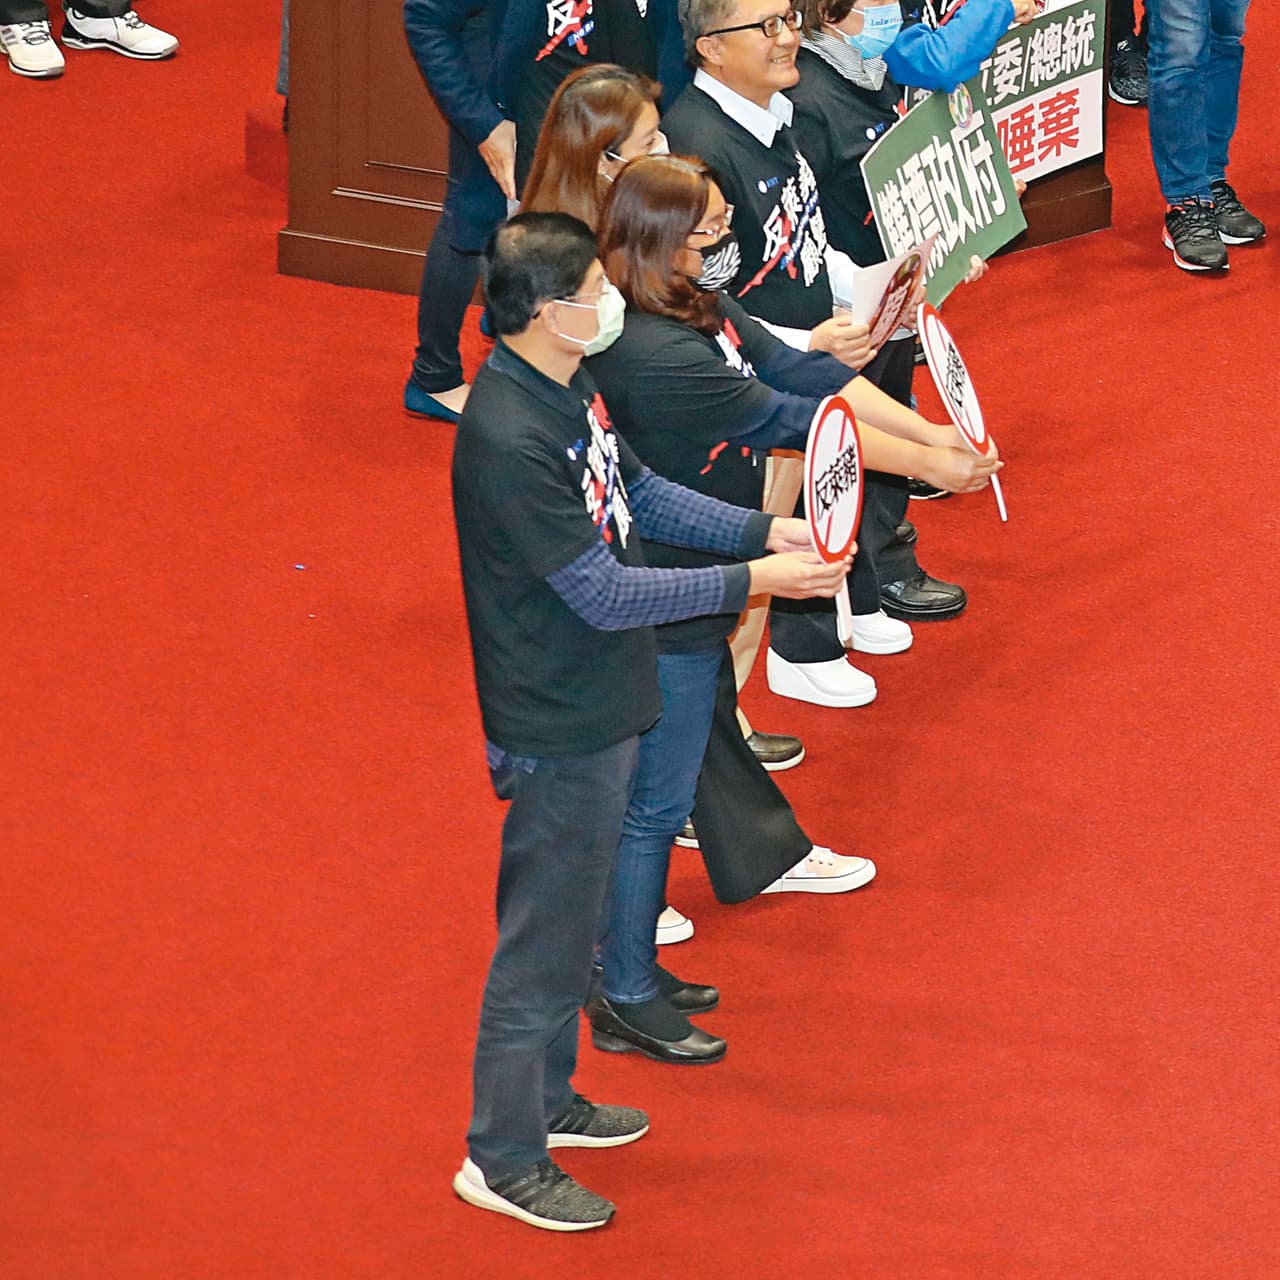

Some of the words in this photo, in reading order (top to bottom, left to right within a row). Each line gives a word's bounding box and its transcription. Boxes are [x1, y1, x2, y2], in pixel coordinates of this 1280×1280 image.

[996, 88, 1080, 174] 唾棄
[876, 110, 1006, 284] 雙標政府
[815, 443, 857, 519] 反萊豬
